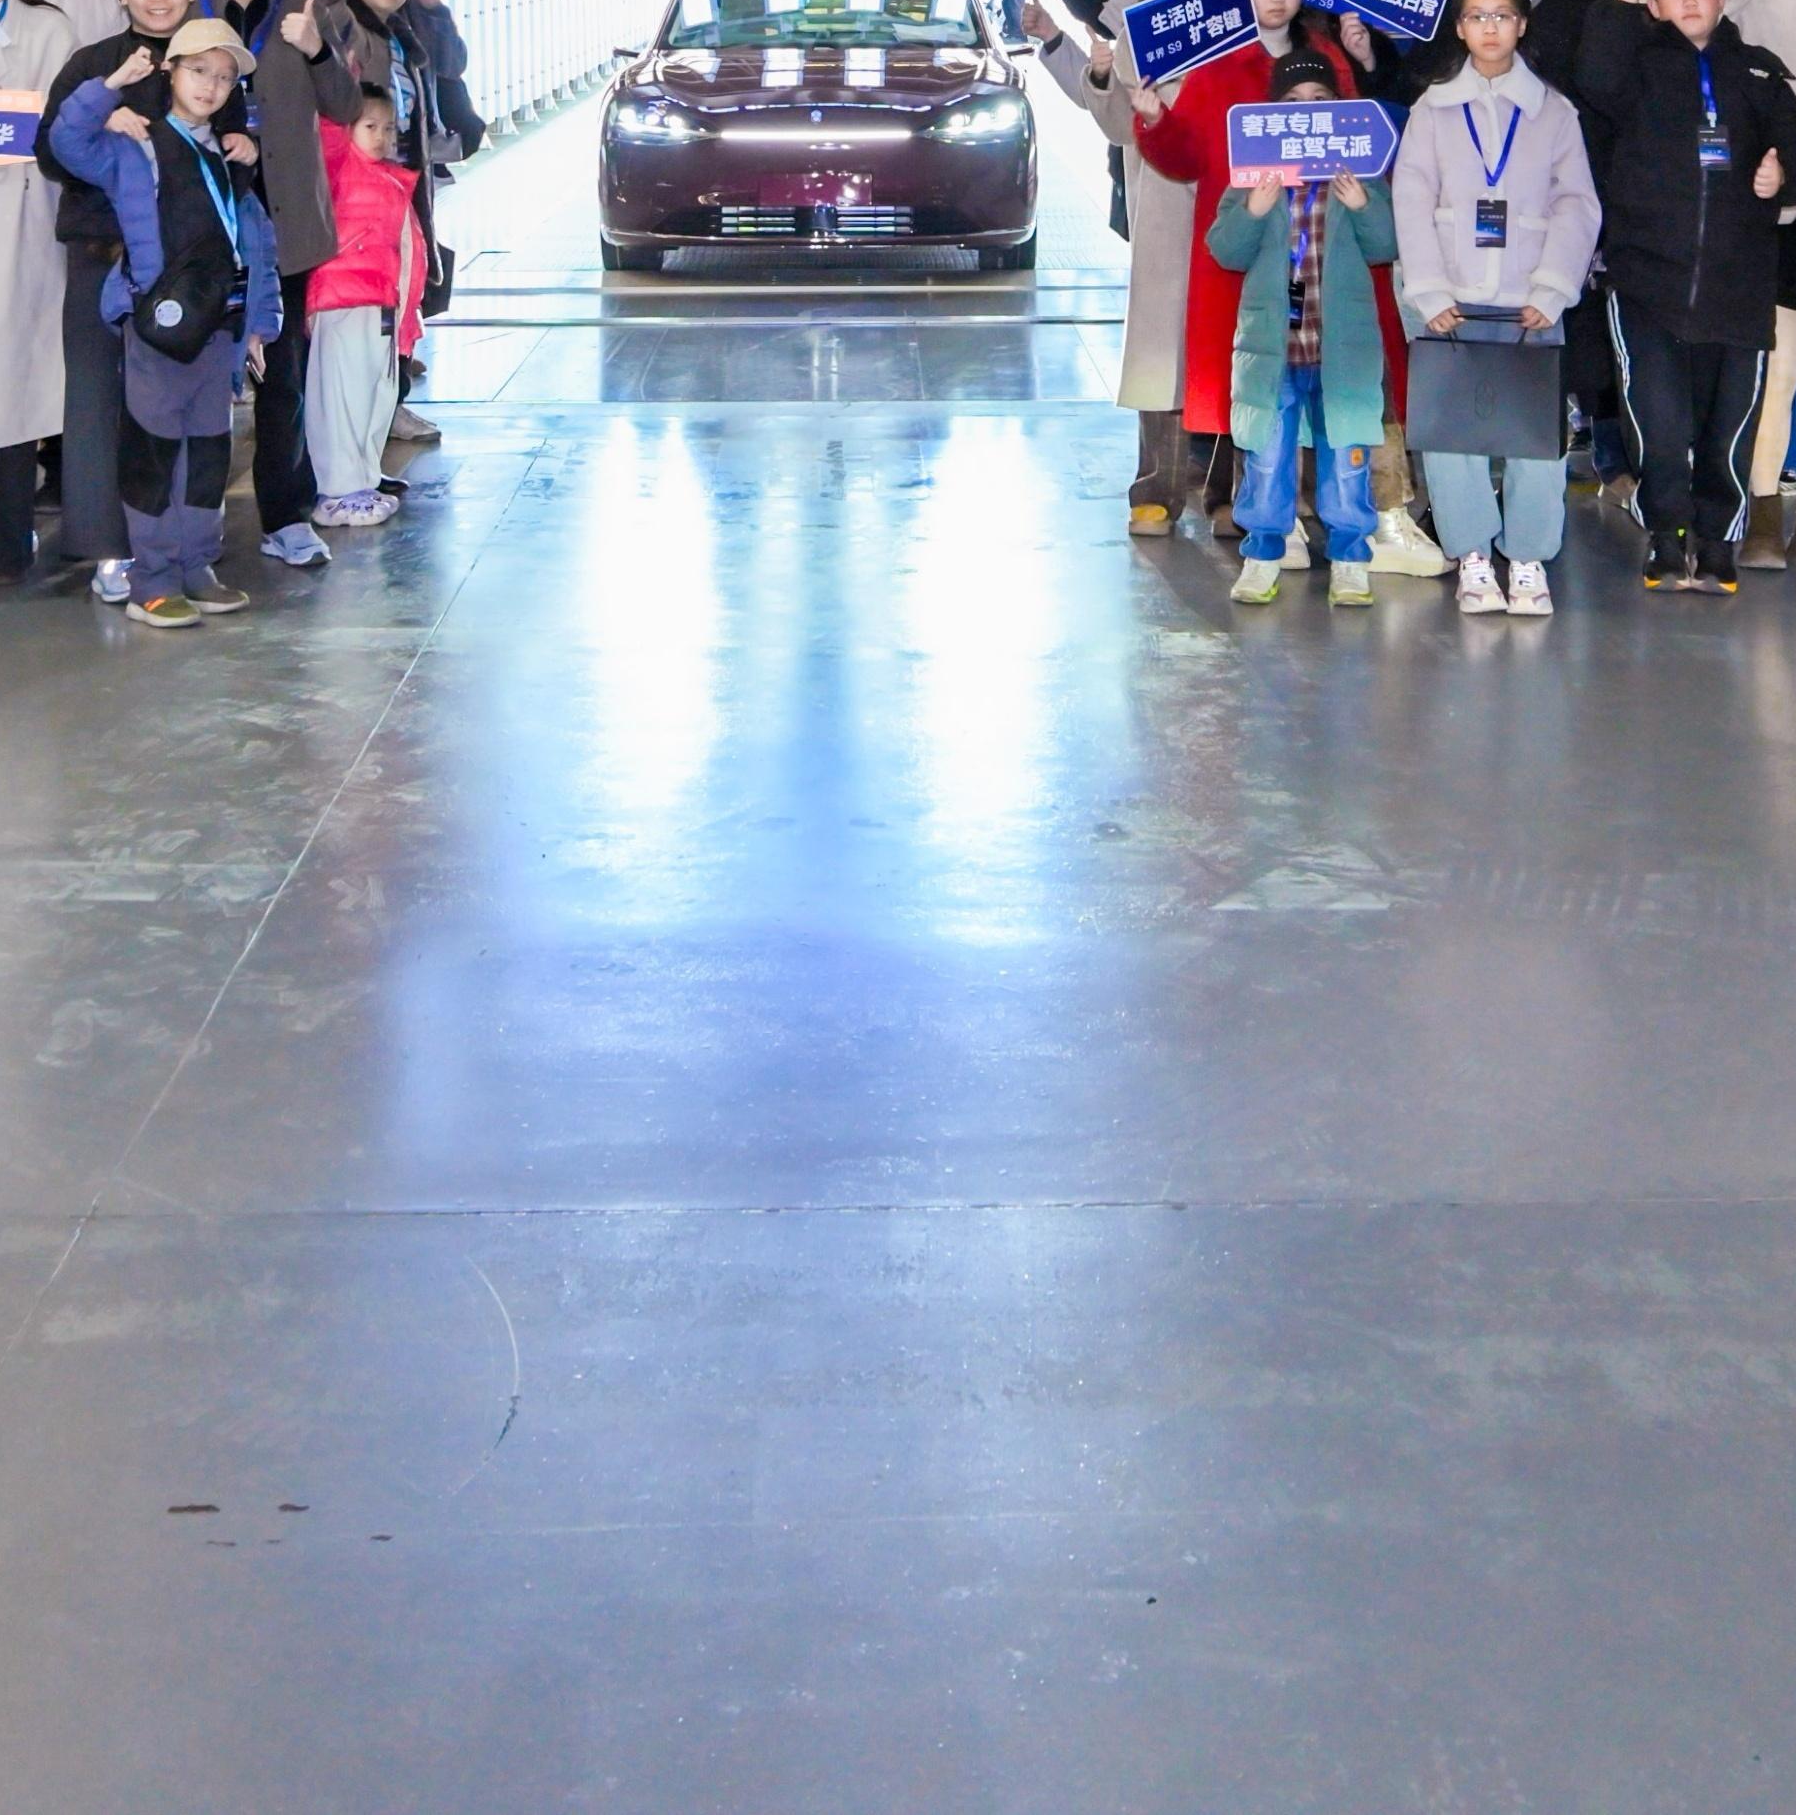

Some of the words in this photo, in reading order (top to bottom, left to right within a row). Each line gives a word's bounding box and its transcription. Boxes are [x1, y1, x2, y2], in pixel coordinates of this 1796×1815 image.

[1188, 7, 1243, 46] 扩容键
[1146, 47, 1165, 63] 享界
[1167, 40, 1183, 55] S9
[1241, 112, 1334, 137] 奢享专属
[1281, 135, 1372, 160] 座驾气派
